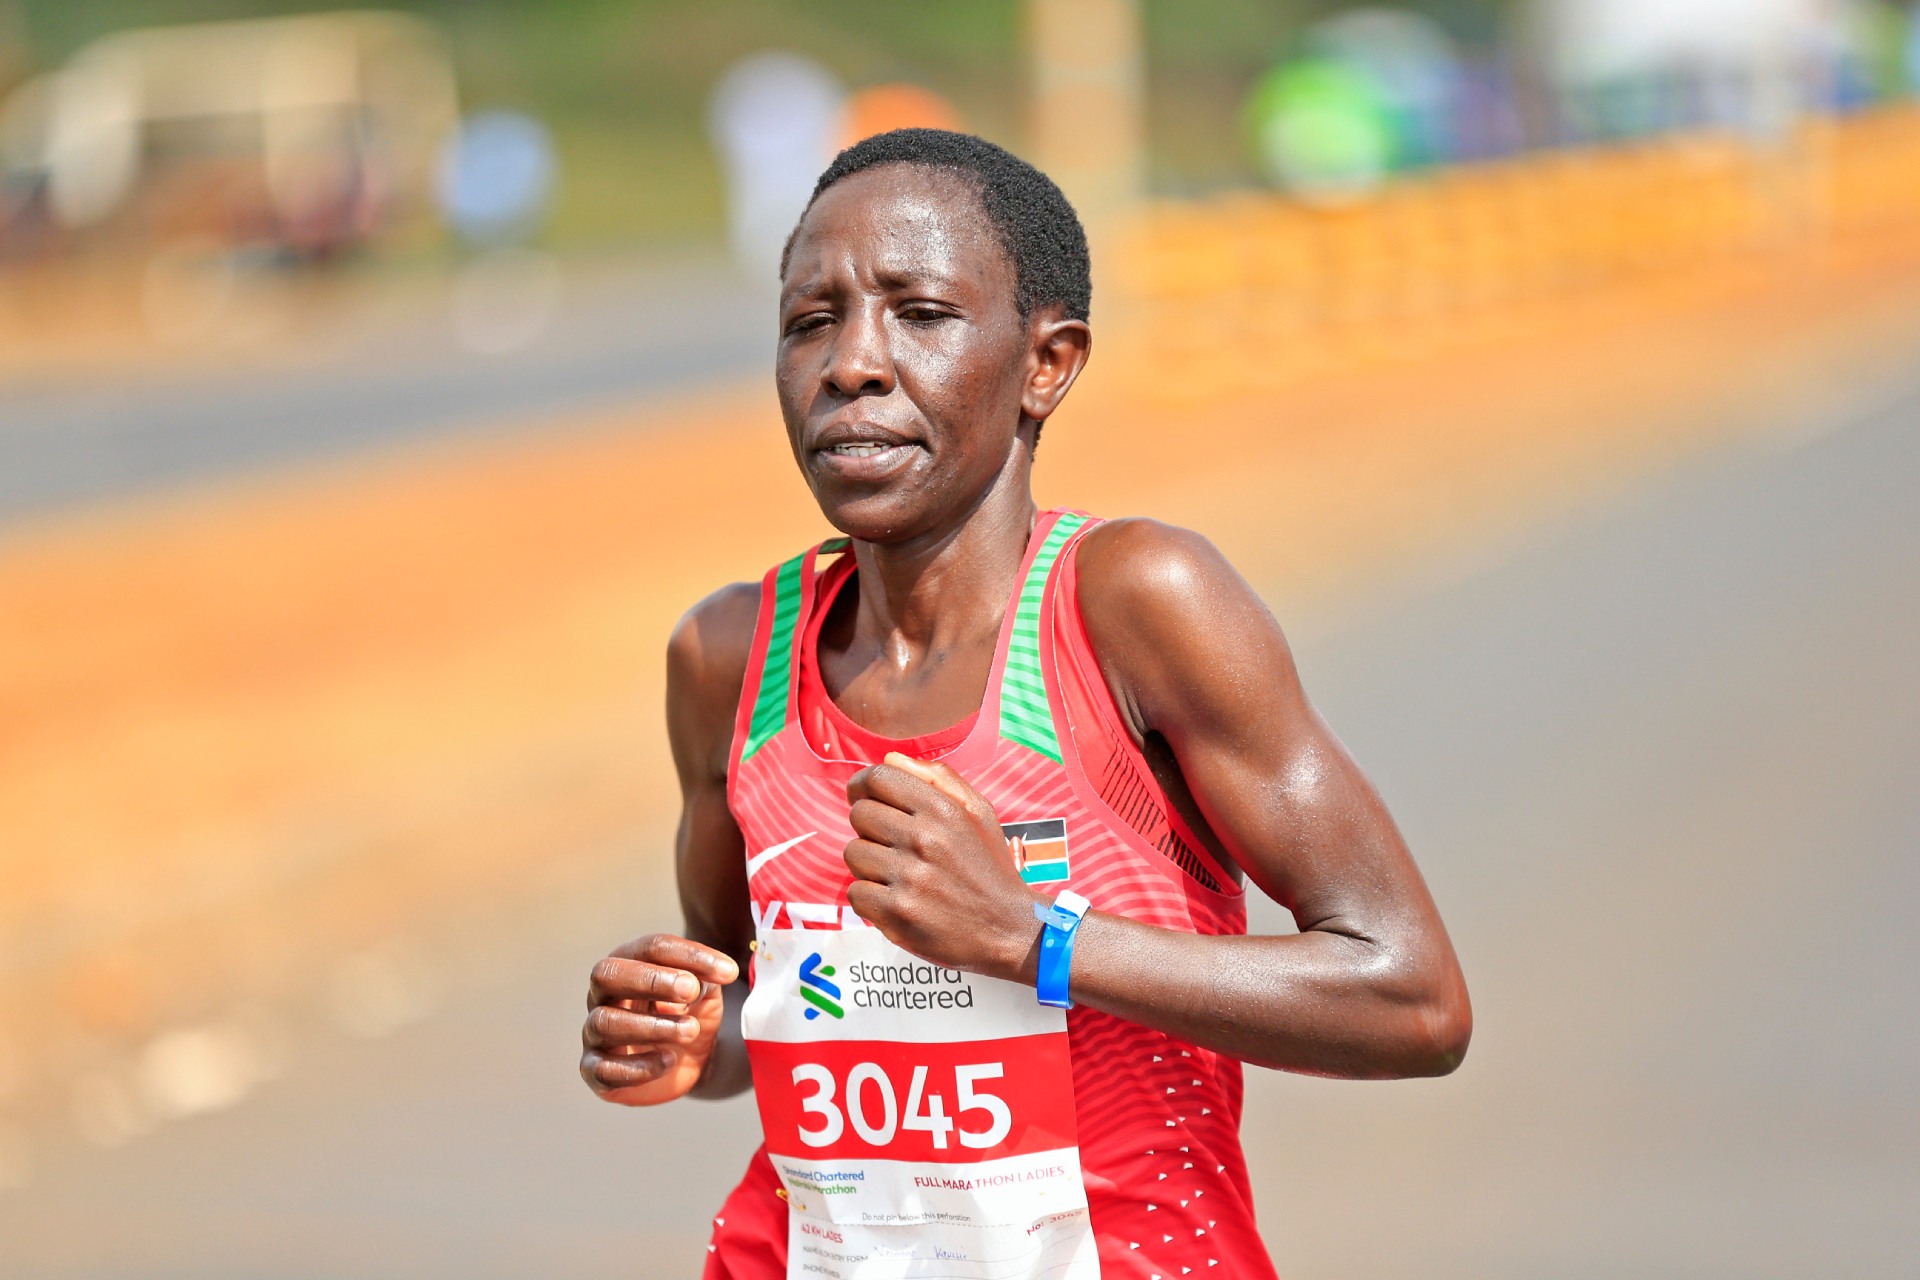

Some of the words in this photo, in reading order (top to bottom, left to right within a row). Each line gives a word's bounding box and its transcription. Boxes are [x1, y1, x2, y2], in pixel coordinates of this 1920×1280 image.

[849, 961, 962, 985] standard
[853, 985, 973, 1009] chartered
[791, 1062, 1012, 1149] 3045
[814, 1170, 865, 1182] Chartered
[914, 1177, 942, 1188] FULL
[943, 1173, 1014, 1191] MARATHON
[1017, 1165, 1065, 1183] LADIES
[862, 1213, 872, 1221] Do
[873, 1213, 884, 1221] not
[886, 1213, 897, 1222] pin
[898, 1213, 919, 1222] below
[921, 1212, 935, 1220] this
[937, 1212, 971, 1223] perforation
[846, 1255, 868, 1263] FORM
